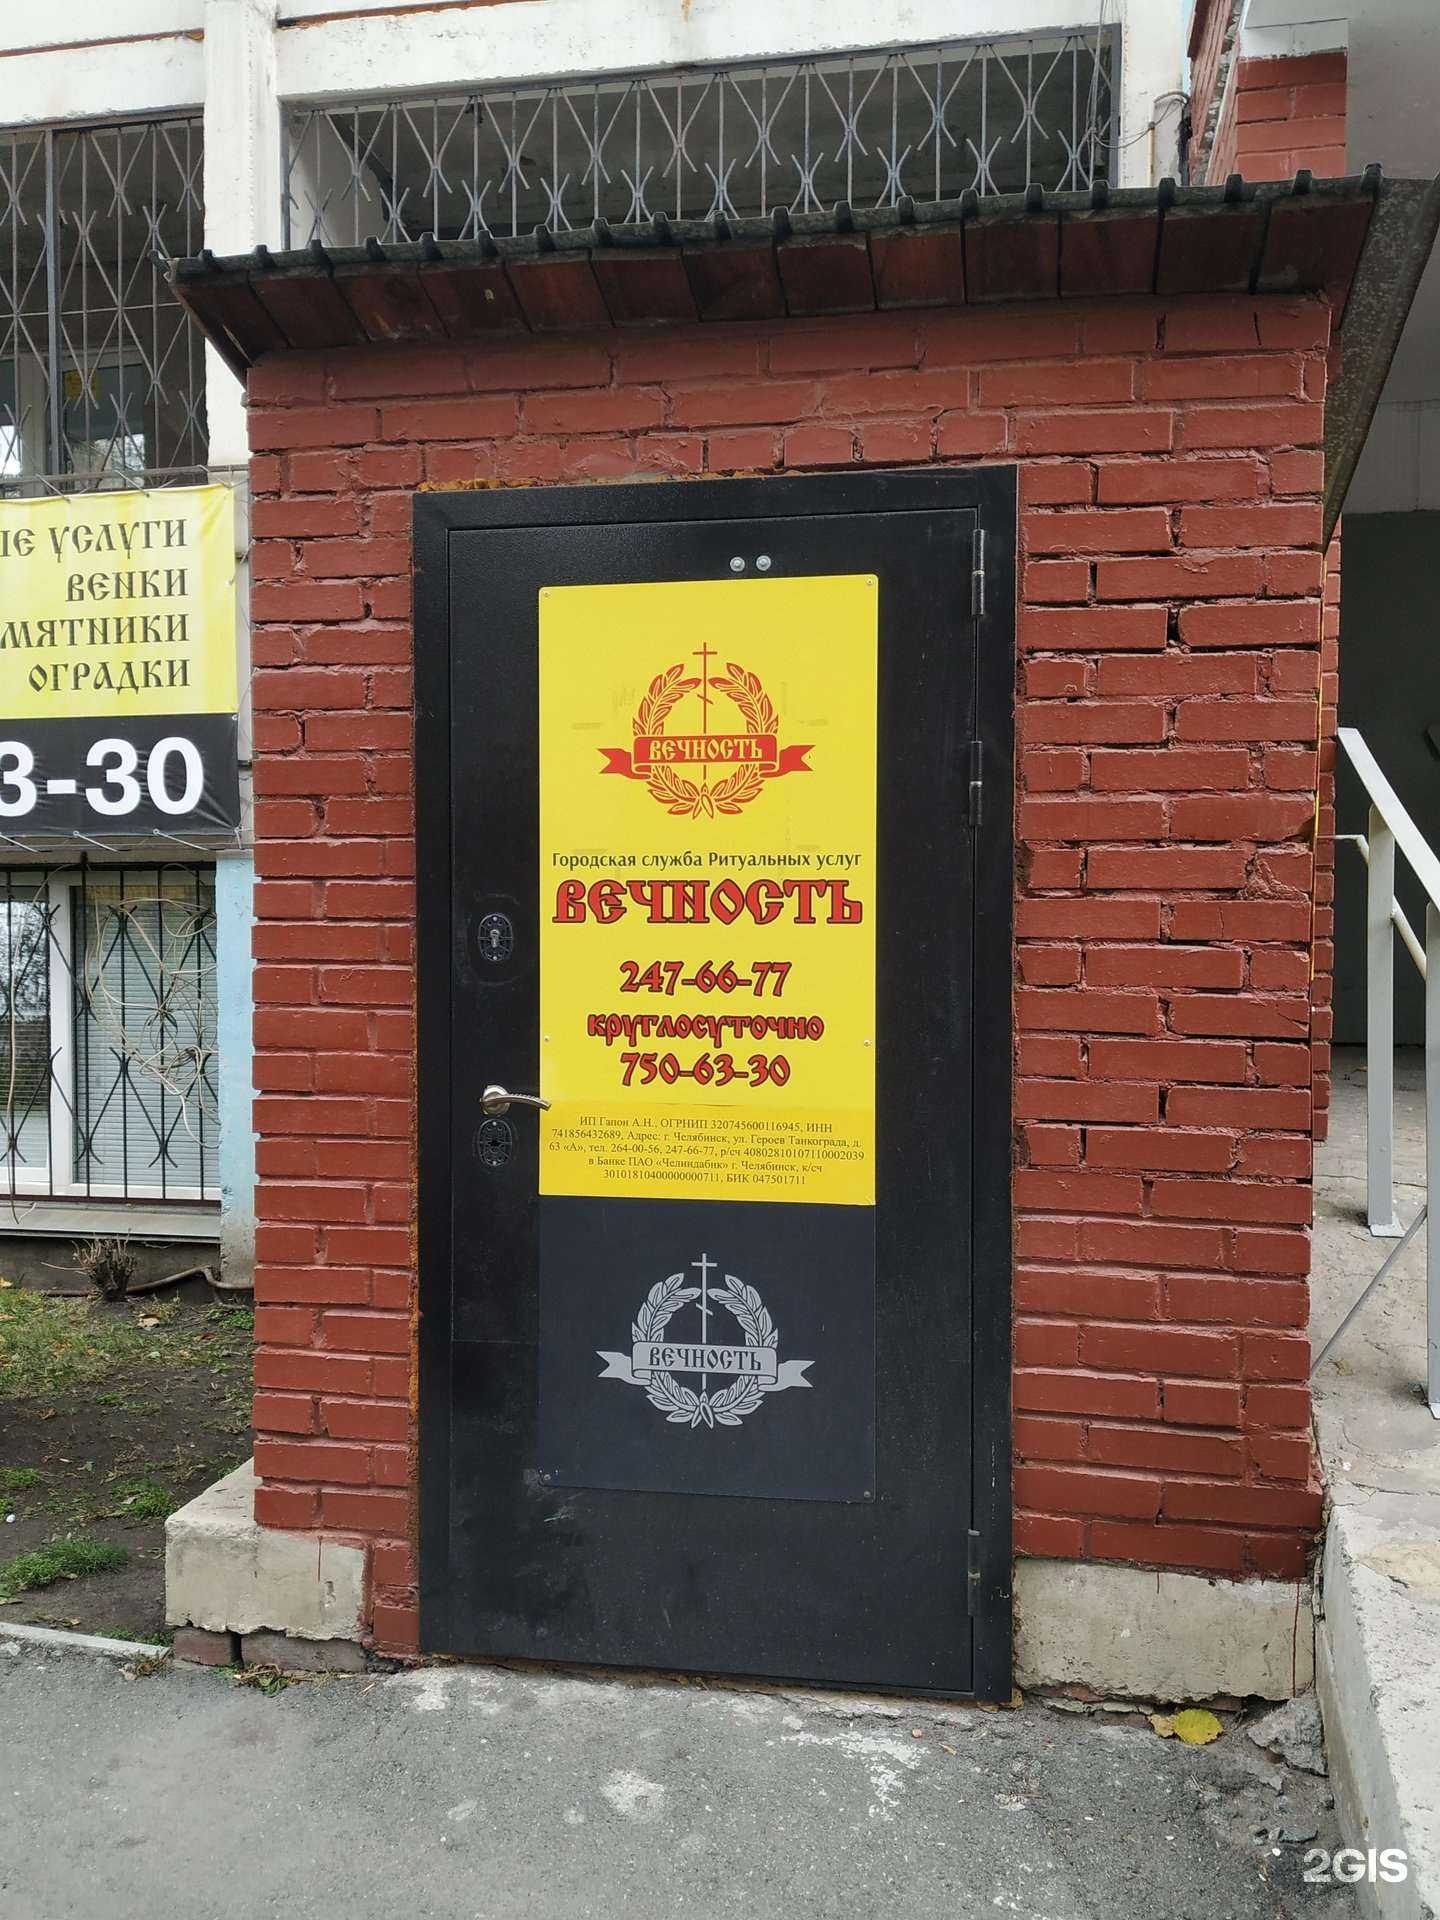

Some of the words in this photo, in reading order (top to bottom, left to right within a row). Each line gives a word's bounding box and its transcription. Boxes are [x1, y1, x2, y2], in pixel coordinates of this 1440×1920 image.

[48, 518, 188, 563] УСЛУГИ
[65, 568, 189, 602] ВЕНКИ
[0, 613, 190, 649] МЯТНИКИ
[28, 658, 191, 695] ОГРАДКИ
[648, 738, 763, 760] ВЕЧНОСТЬ
[0, 736, 204, 817] 3-30
[552, 852, 636, 871] Городская
[641, 851, 703, 871] служба
[708, 852, 811, 871] Ритуальных
[816, 854, 862, 871] услуг
[552, 878, 863, 925] ВЕЧНОСТЬ
[619, 960, 792, 997] 247-66-77
[620, 1052, 791, 1087] 750-63-30
[551, 1129, 624, 1140] 741856432689,
[627, 1131, 661, 1142] Адрес:
[673, 1132, 730, 1143] Челябинск,
[733, 1136, 747, 1144] ул.
[750, 1135, 785, 1146] Героев
[788, 1135, 850, 1149] Танкограда,
[580, 1117, 596, 1126] ИП
[599, 1117, 629, 1127] Гапон
[660, 1118, 708, 1129] ОГРНИП
[711, 1119, 803, 1133] 320745600116945,
[806, 1123, 833, 1133] ИНН
[549, 1142, 561, 1151] 63
[589, 1145, 608, 1153] тел.
[611, 1143, 663, 1154] 264-00-56,
[665, 1146, 718, 1157] 247-66-77,
[720, 1147, 741, 1157] р/сч
[743, 1147, 865, 1161] 40802810107110002039
[597, 1157, 625, 1166] Банке
[628, 1157, 653, 1167] ПАО
[741, 1160, 799, 1172] Челябинск,
[802, 1164, 823, 1173] к/сч
[603, 1169, 723, 1183] 30101810400000000711,
[726, 1174, 750, 1183] БИК
[752, 1174, 806, 1185] 047501711
[649, 1346, 761, 1371] ВЕЧНОСТЬ
